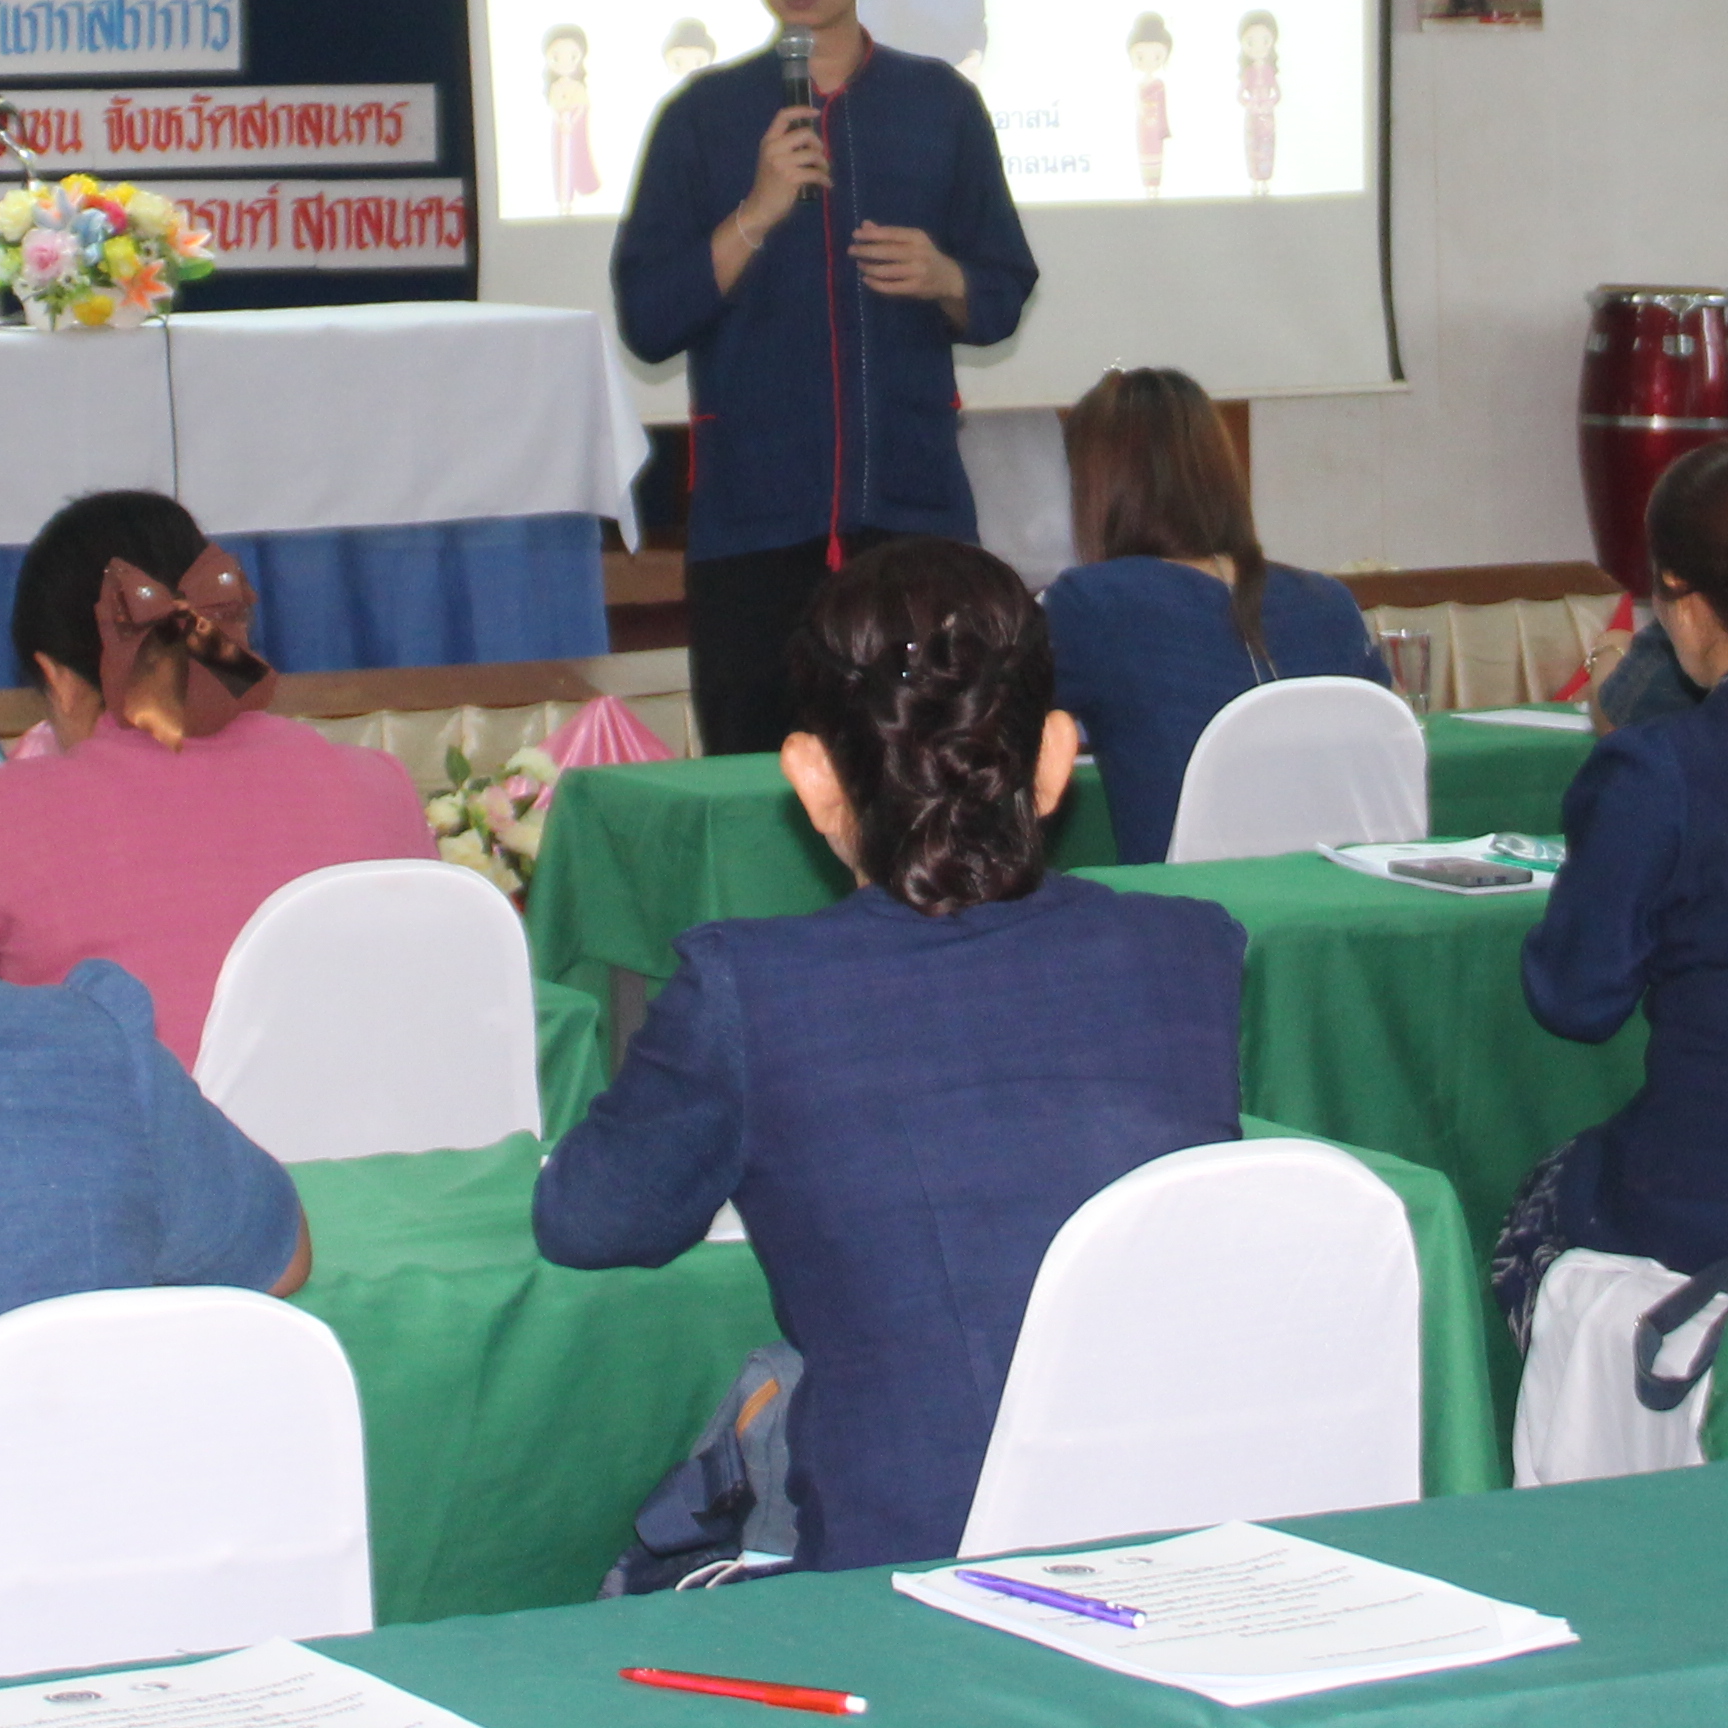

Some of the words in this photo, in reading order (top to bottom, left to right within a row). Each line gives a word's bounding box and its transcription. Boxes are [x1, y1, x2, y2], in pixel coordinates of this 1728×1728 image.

[104, 94, 411, 155] จังหวัดสกลนคร
[1001, 153, 1093, 175] กลนคร
[291, 190, 467, 254] สกลนคร
